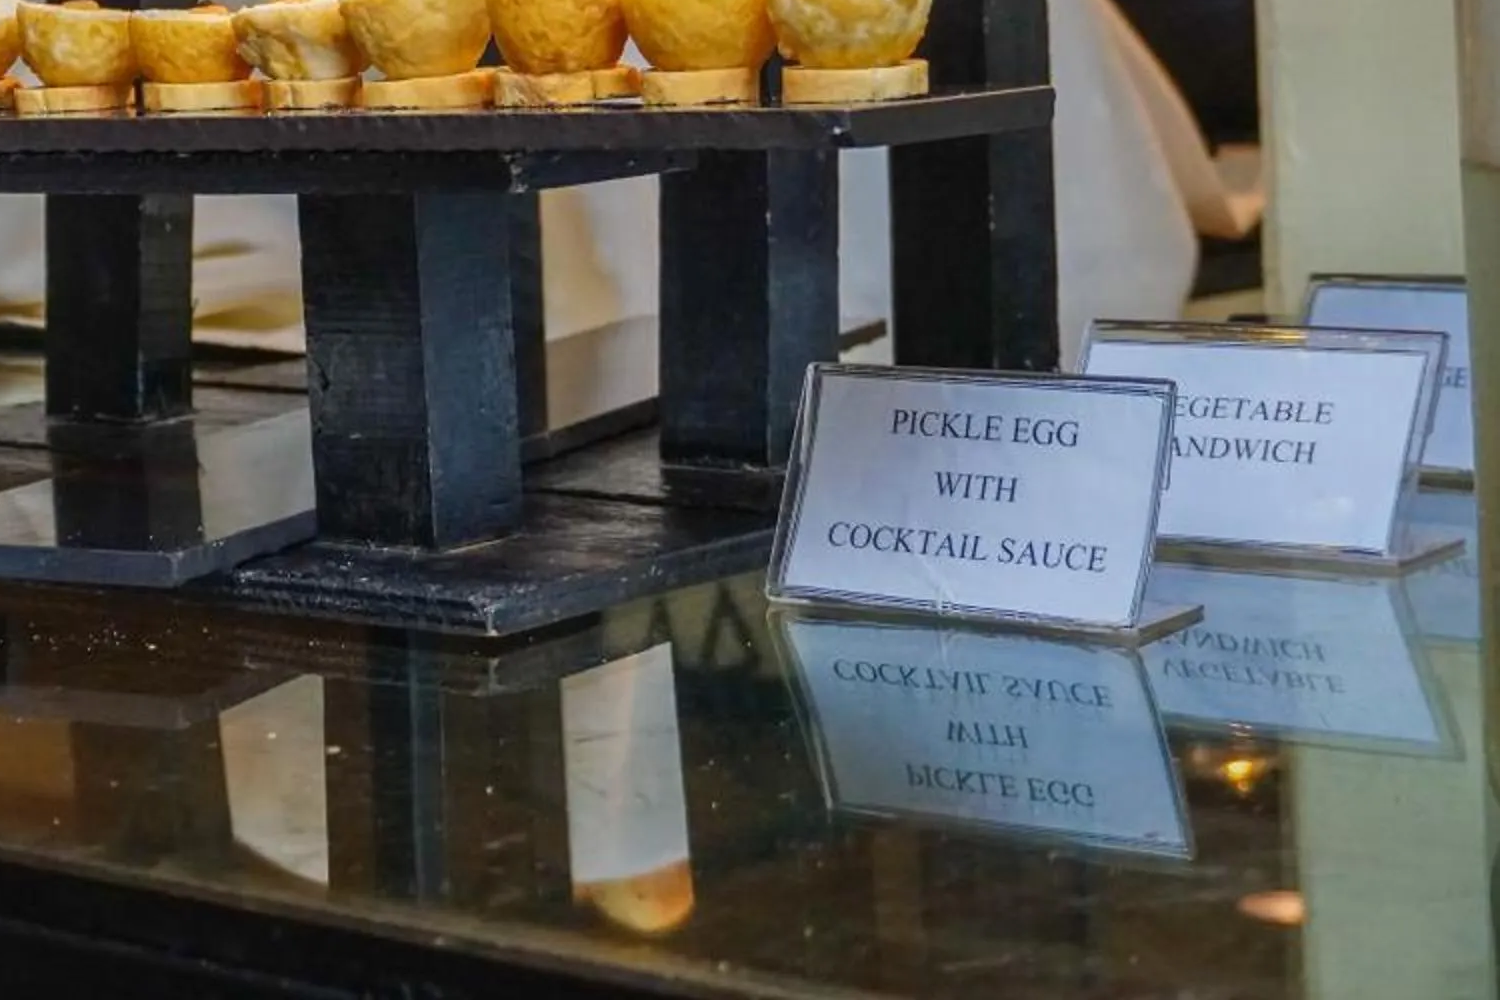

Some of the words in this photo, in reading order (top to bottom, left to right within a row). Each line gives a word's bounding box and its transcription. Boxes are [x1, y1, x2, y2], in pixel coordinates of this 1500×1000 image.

[1174, 395, 1334, 424] EGETABLE
[892, 409, 1002, 441] PICKLE
[1012, 417, 1079, 447] EGG
[1170, 435, 1316, 464] ANDWICH
[934, 471, 1018, 502] WITH
[828, 521, 987, 561] COCKTAIL
[998, 537, 1107, 572] SAUCE
